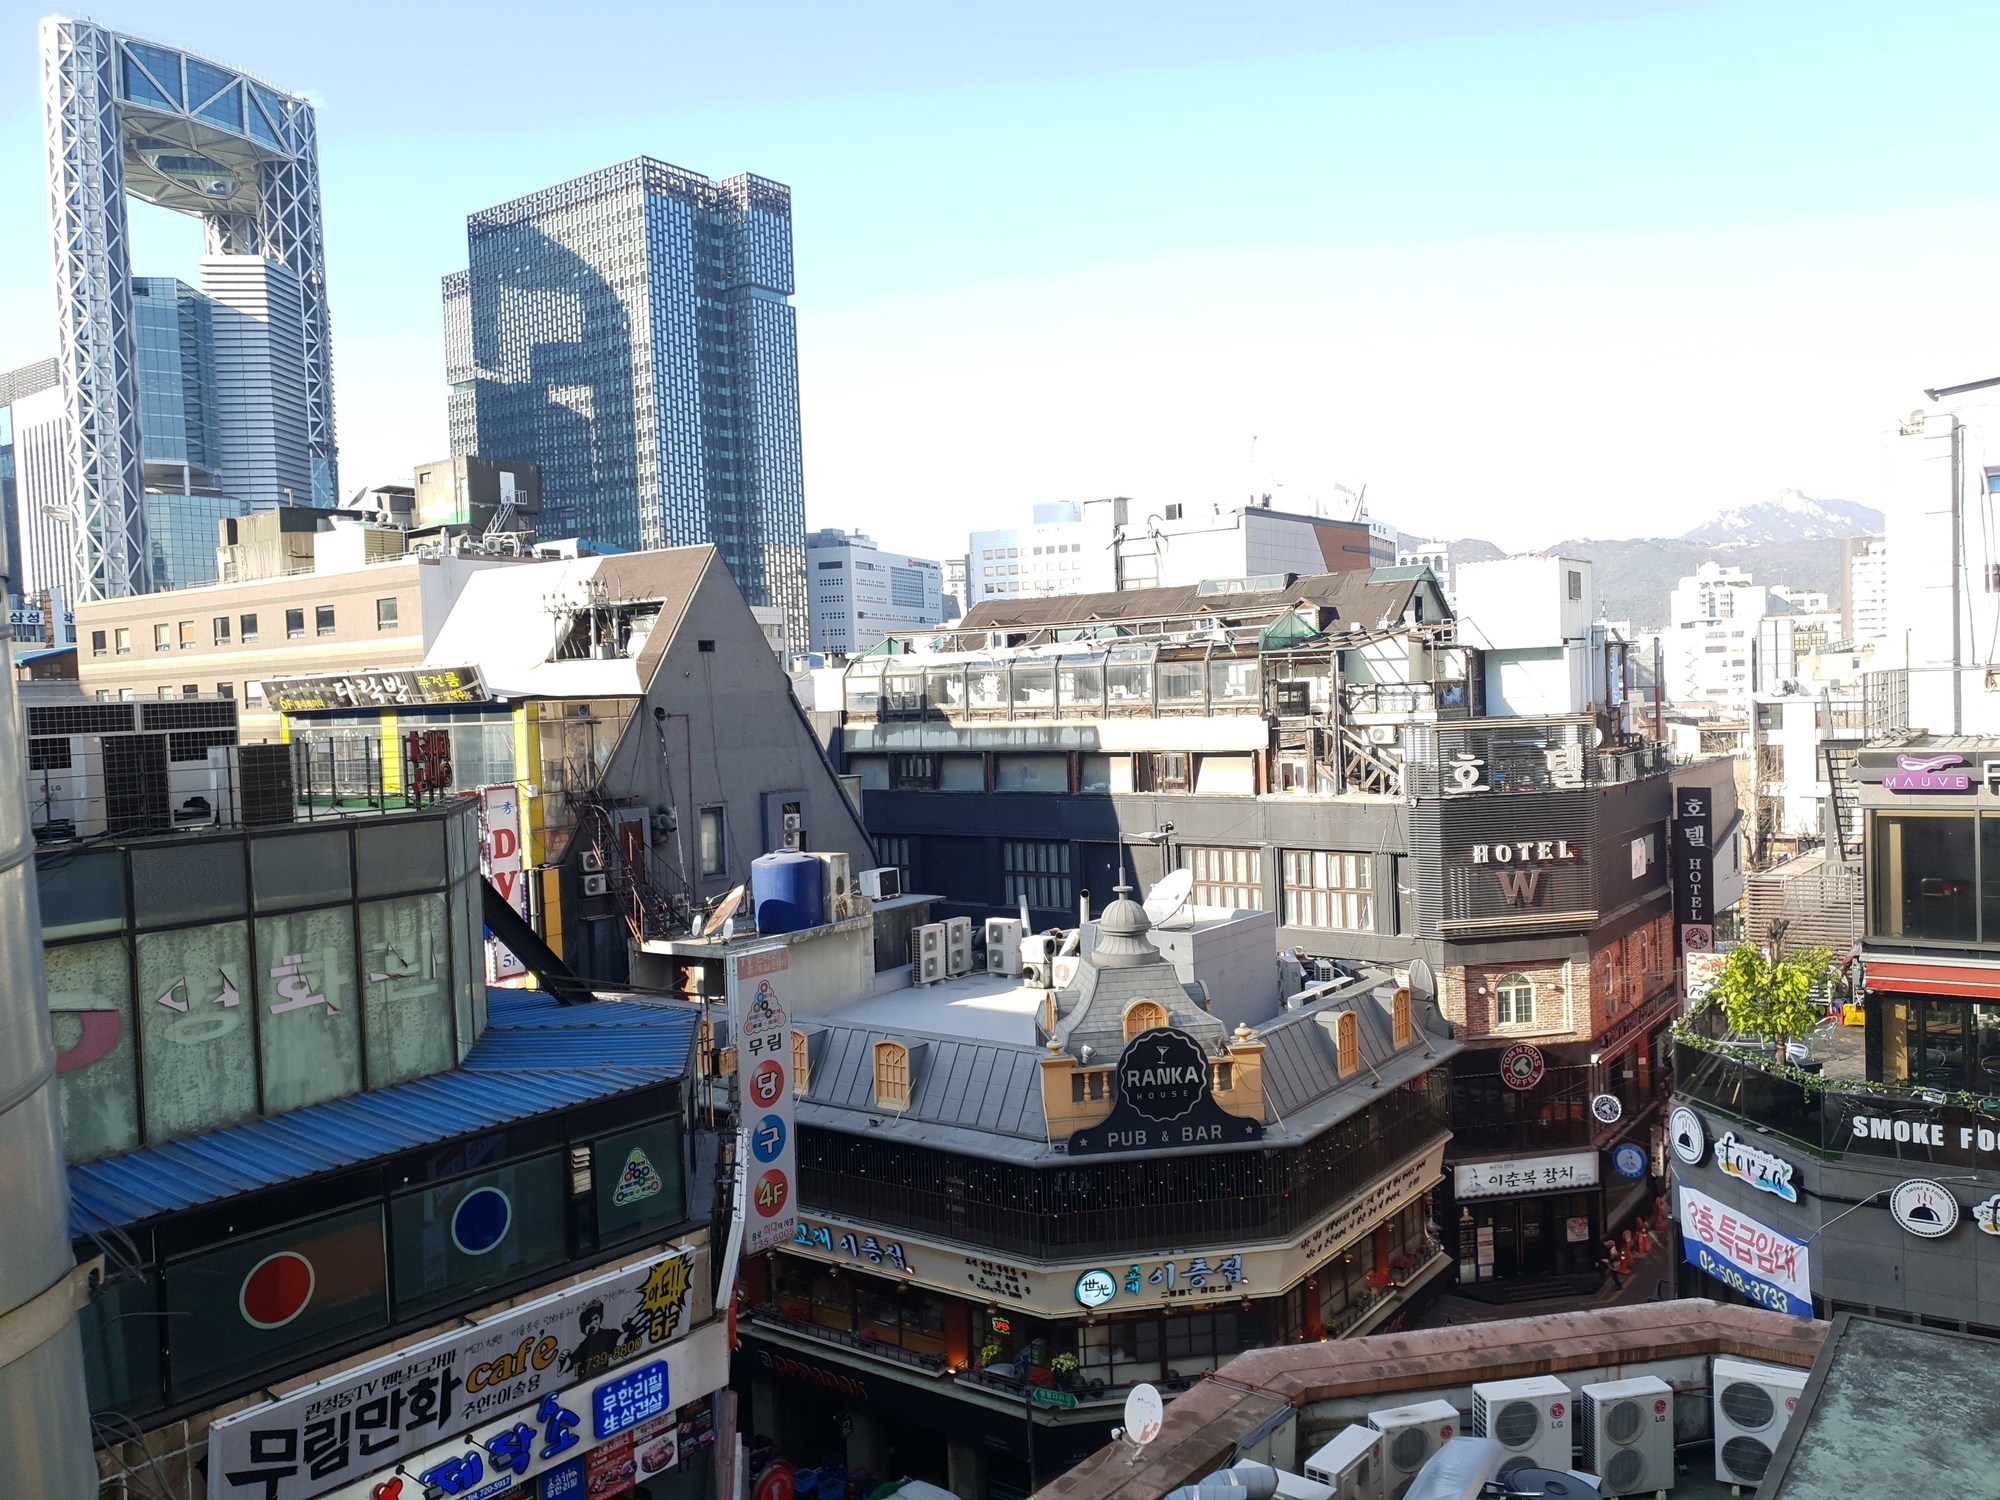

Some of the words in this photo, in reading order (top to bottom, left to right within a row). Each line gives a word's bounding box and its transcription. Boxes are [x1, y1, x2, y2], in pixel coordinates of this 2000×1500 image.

[11, 612, 40, 623] 삼성
[332, 675, 408, 706] 다락방
[1444, 743, 1584, 792] 호텔
[1885, 777, 1966, 788] MAUVE
[1683, 798, 1706, 847] 호텔
[1473, 841, 1574, 864] HOTEL
[1497, 870, 1541, 904] W
[1690, 858, 1703, 921] HOTEL
[749, 1033, 782, 1056] 무림
[1503, 1050, 1516, 1069] TOM
[1523, 1046, 1541, 1067] TOMS
[1127, 1066, 1199, 1088] RANKA
[1505, 1070, 1539, 1086] COFFEE
[1137, 1090, 1188, 1100] HOUSE
[1108, 1130, 1147, 1147] PUB
[1161, 1131, 1169, 1142] &
[1182, 1124, 1222, 1142] BAR
[1852, 1115, 1944, 1147] SMOKE
[1960, 1123, 2000, 1152] FO
[1722, 1136, 1786, 1191] forza
[1488, 1169, 1537, 1188] 이춘복
[1905, 1185, 1924, 1194] SMOKE
[758, 1181, 785, 1208] 4F
[752, 1227, 795, 1251] 735-6005
[840, 1233, 906, 1270] 이층집
[1718, 1214, 1796, 1283] 특급임대
[1149, 1254, 1244, 1290] 이층집
[1700, 1249, 1788, 1315] 02-508-3733
[651, 1313, 677, 1342] 5F
[603, 1372, 662, 1412] 무한리필
[603, 1392, 664, 1435] 生삼겹살
[1552, 1420, 1564, 1430] LG
[1656, 1415, 1666, 1423] LG
[225, 1364, 463, 1500] 무림만화
